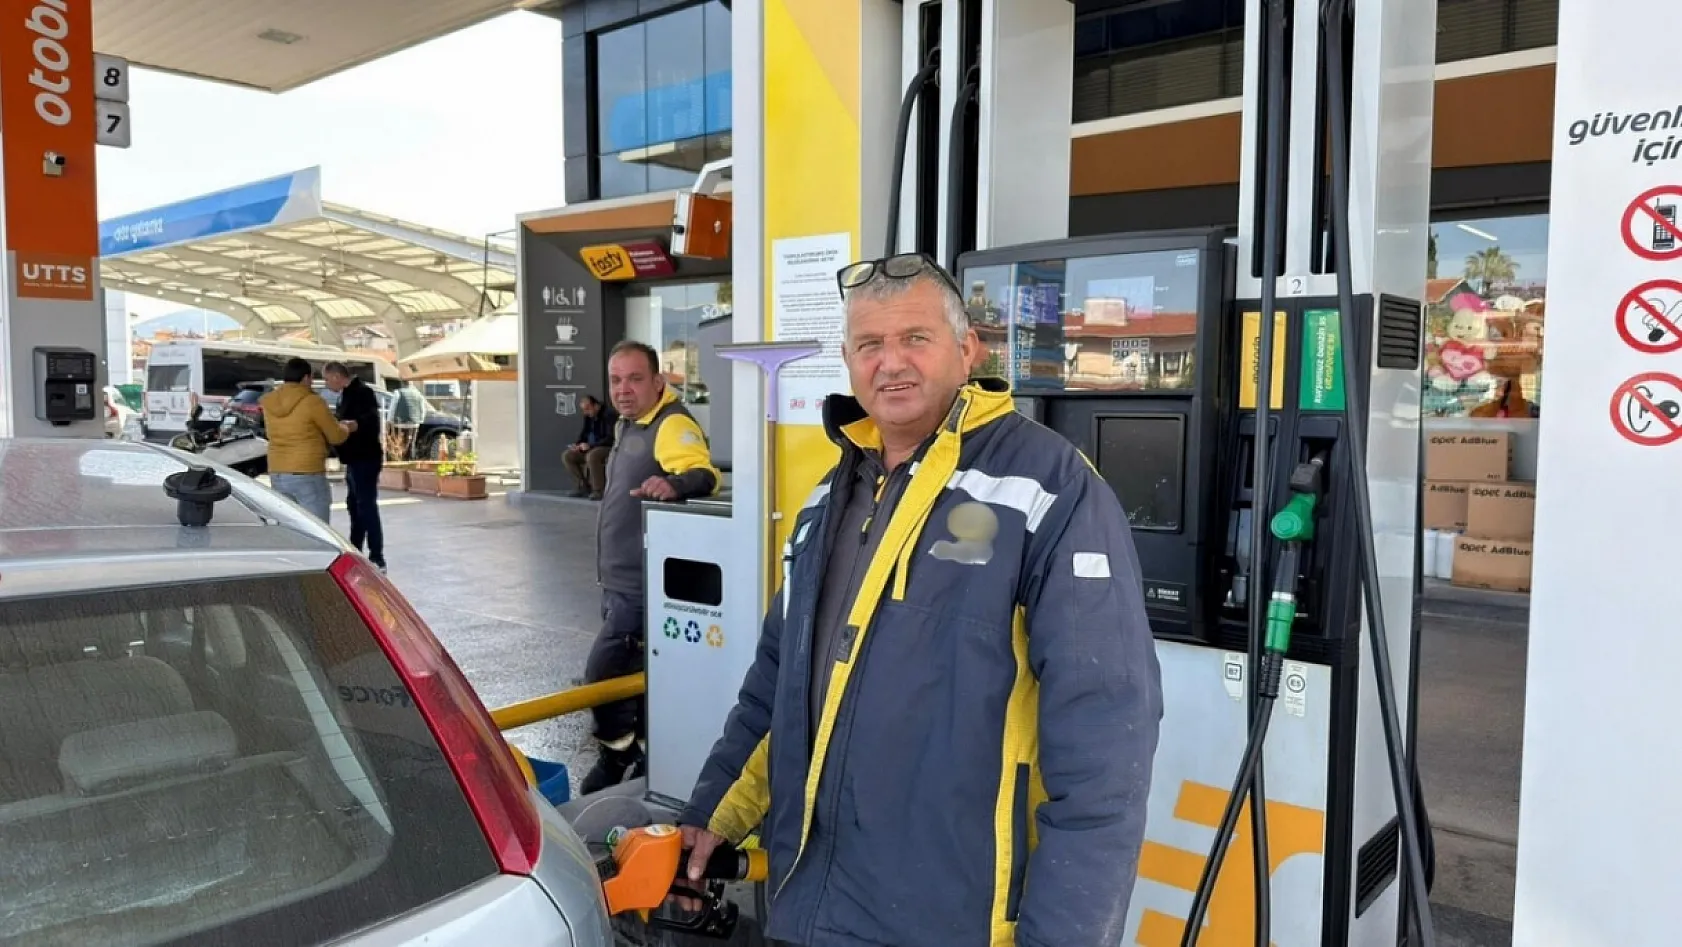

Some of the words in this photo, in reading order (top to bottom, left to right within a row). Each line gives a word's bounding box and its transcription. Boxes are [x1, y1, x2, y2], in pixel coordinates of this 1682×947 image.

[103, 67, 120, 87] 8
[106, 114, 122, 134] 7
[1568, 105, 1682, 145] güvenl
[22, 262, 87, 283] UTTS
[1291, 278, 1302, 294] 2
[1504, 489, 1536, 499] AdBlu
